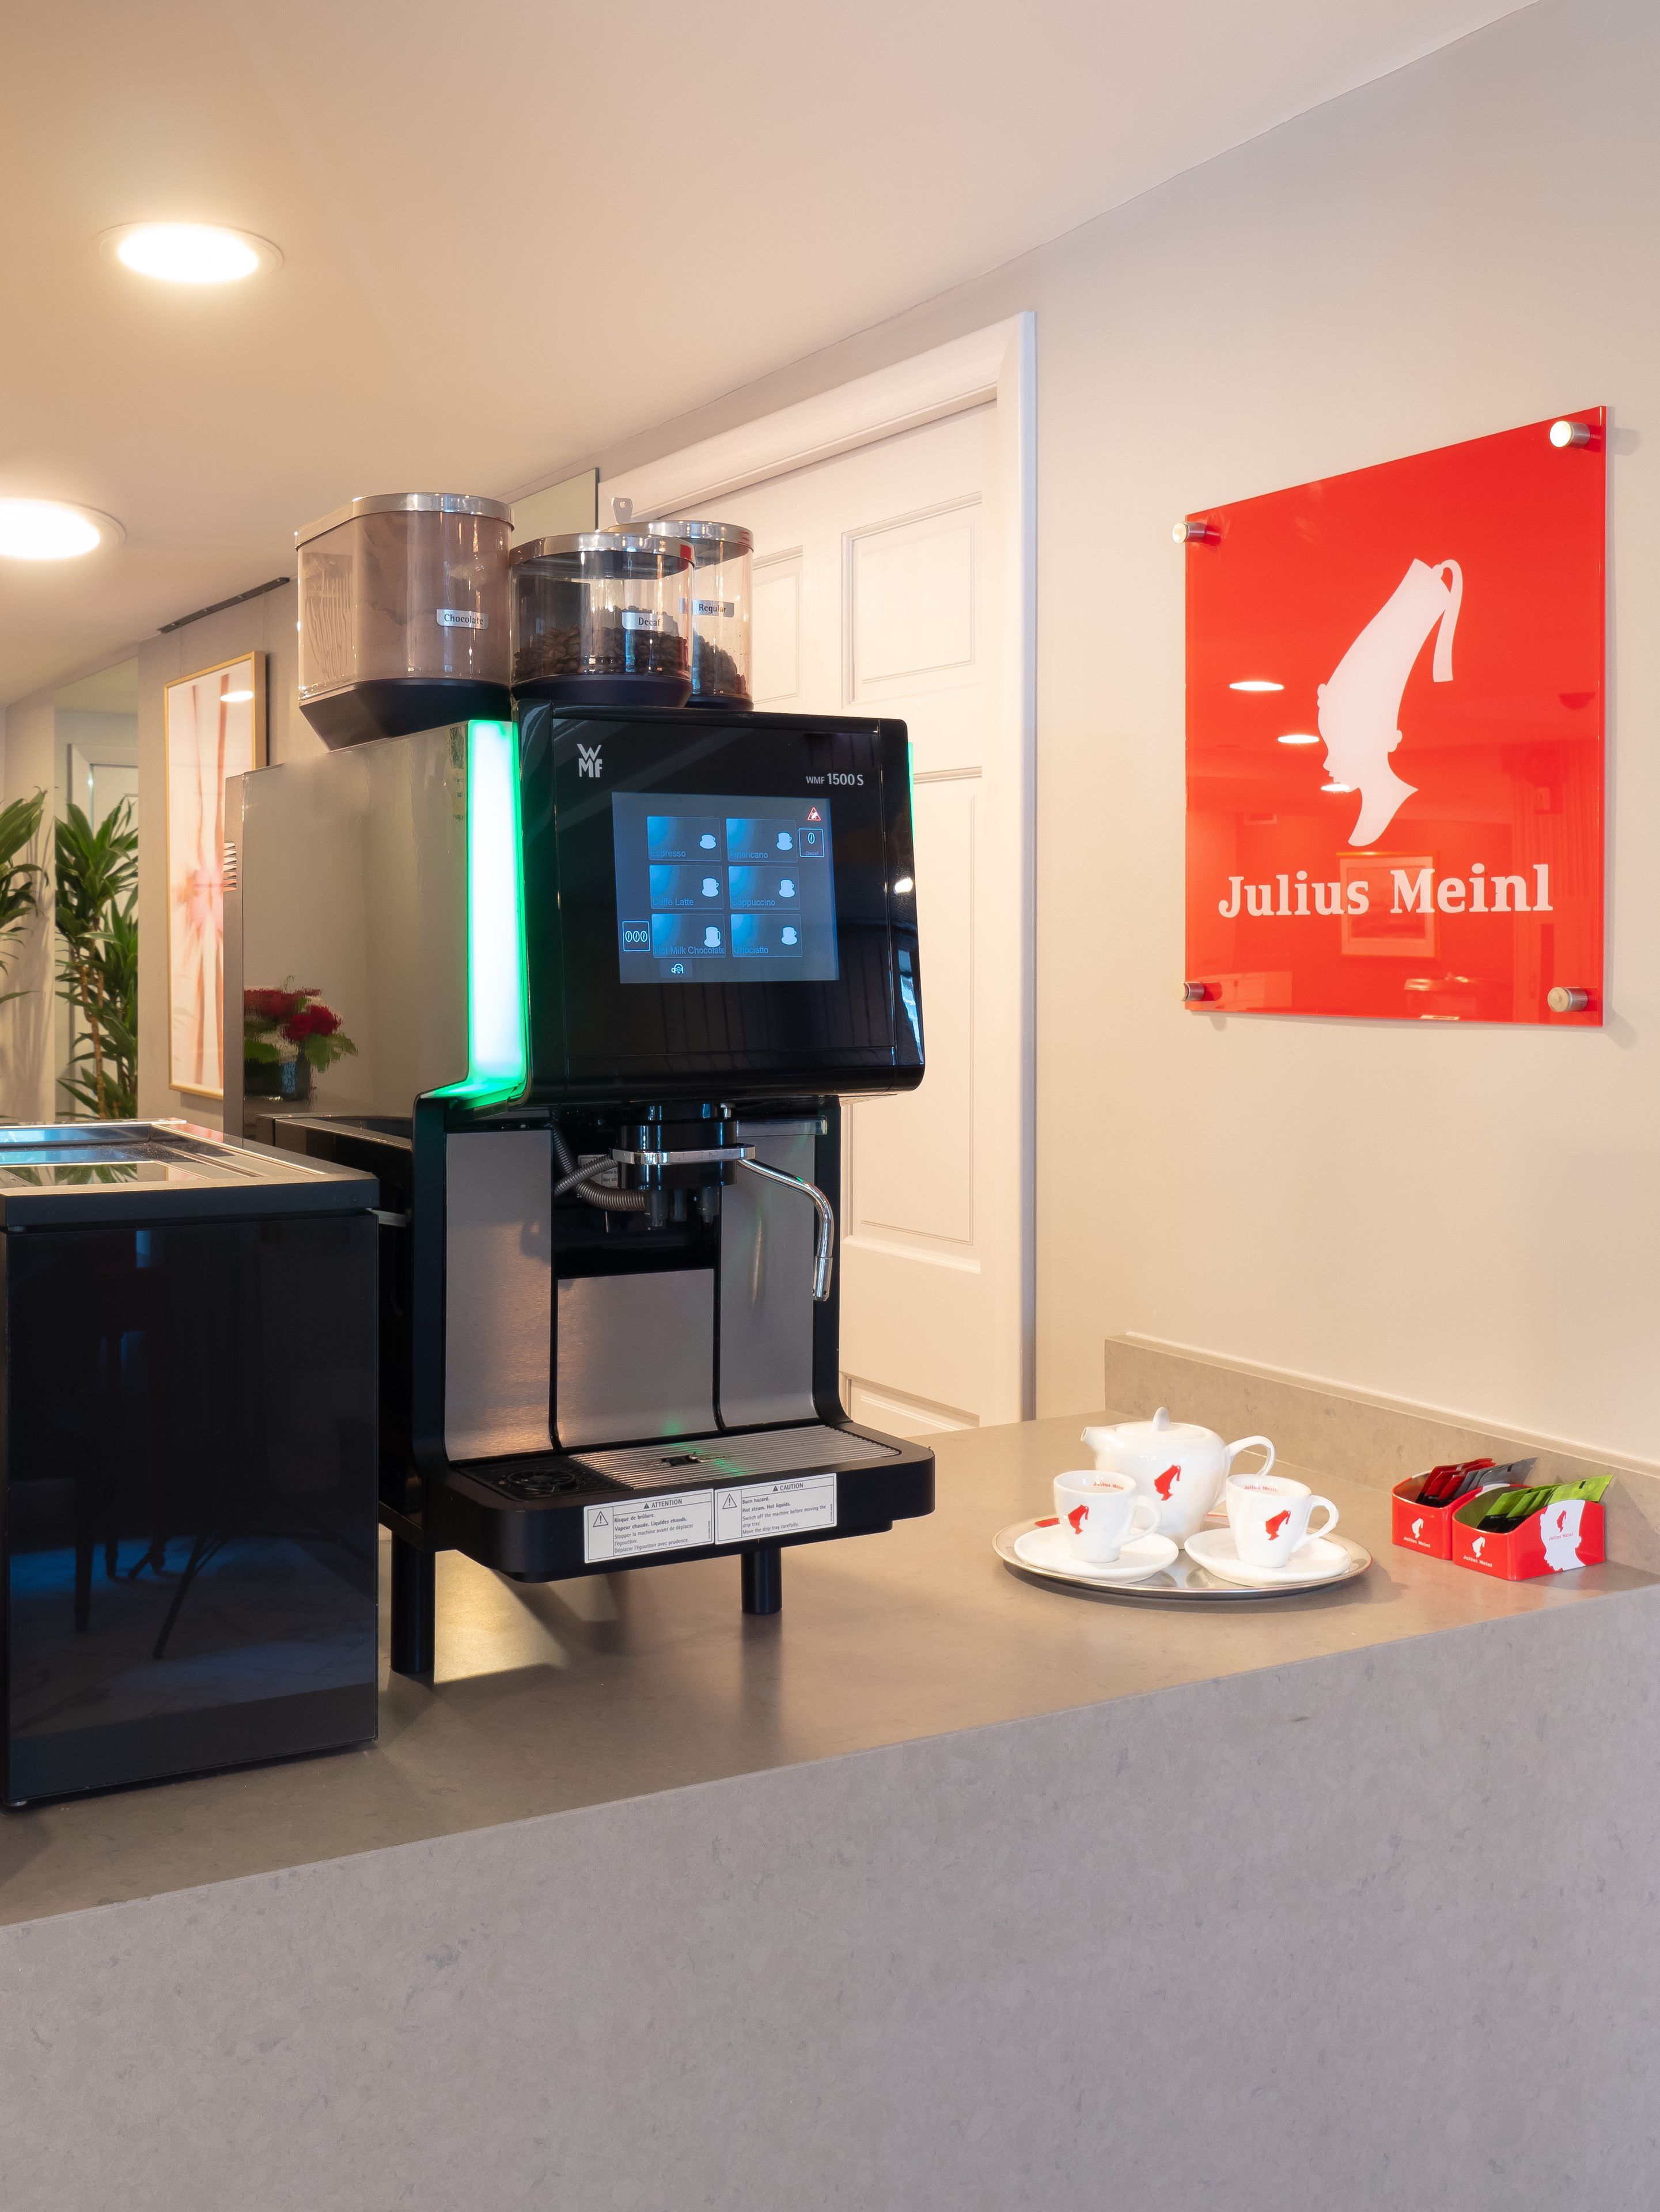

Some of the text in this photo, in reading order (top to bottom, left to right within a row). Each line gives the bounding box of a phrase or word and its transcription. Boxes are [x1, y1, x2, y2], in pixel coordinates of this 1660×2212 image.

[699, 604, 726, 613] Regular
[444, 613, 483, 624] Chocolate
[638, 617, 661, 626] Decaf
[806, 773, 864, 786] WMF 1500 S
[650, 850, 686, 858] Espresso
[729, 850, 768, 858] Americano
[1218, 863, 1553, 918] Julius Meinl
[675, 897, 694, 906] Latte
[732, 898, 776, 908] Cappuccino
[654, 946, 725, 955] Hot Milk Chocolate
[733, 946, 769, 954] Chociatto
[779, 1483, 804, 1491] CAUTION
[651, 1499, 683, 1508] ATTENTION
[1462, 1555, 1478, 1563] Julius
